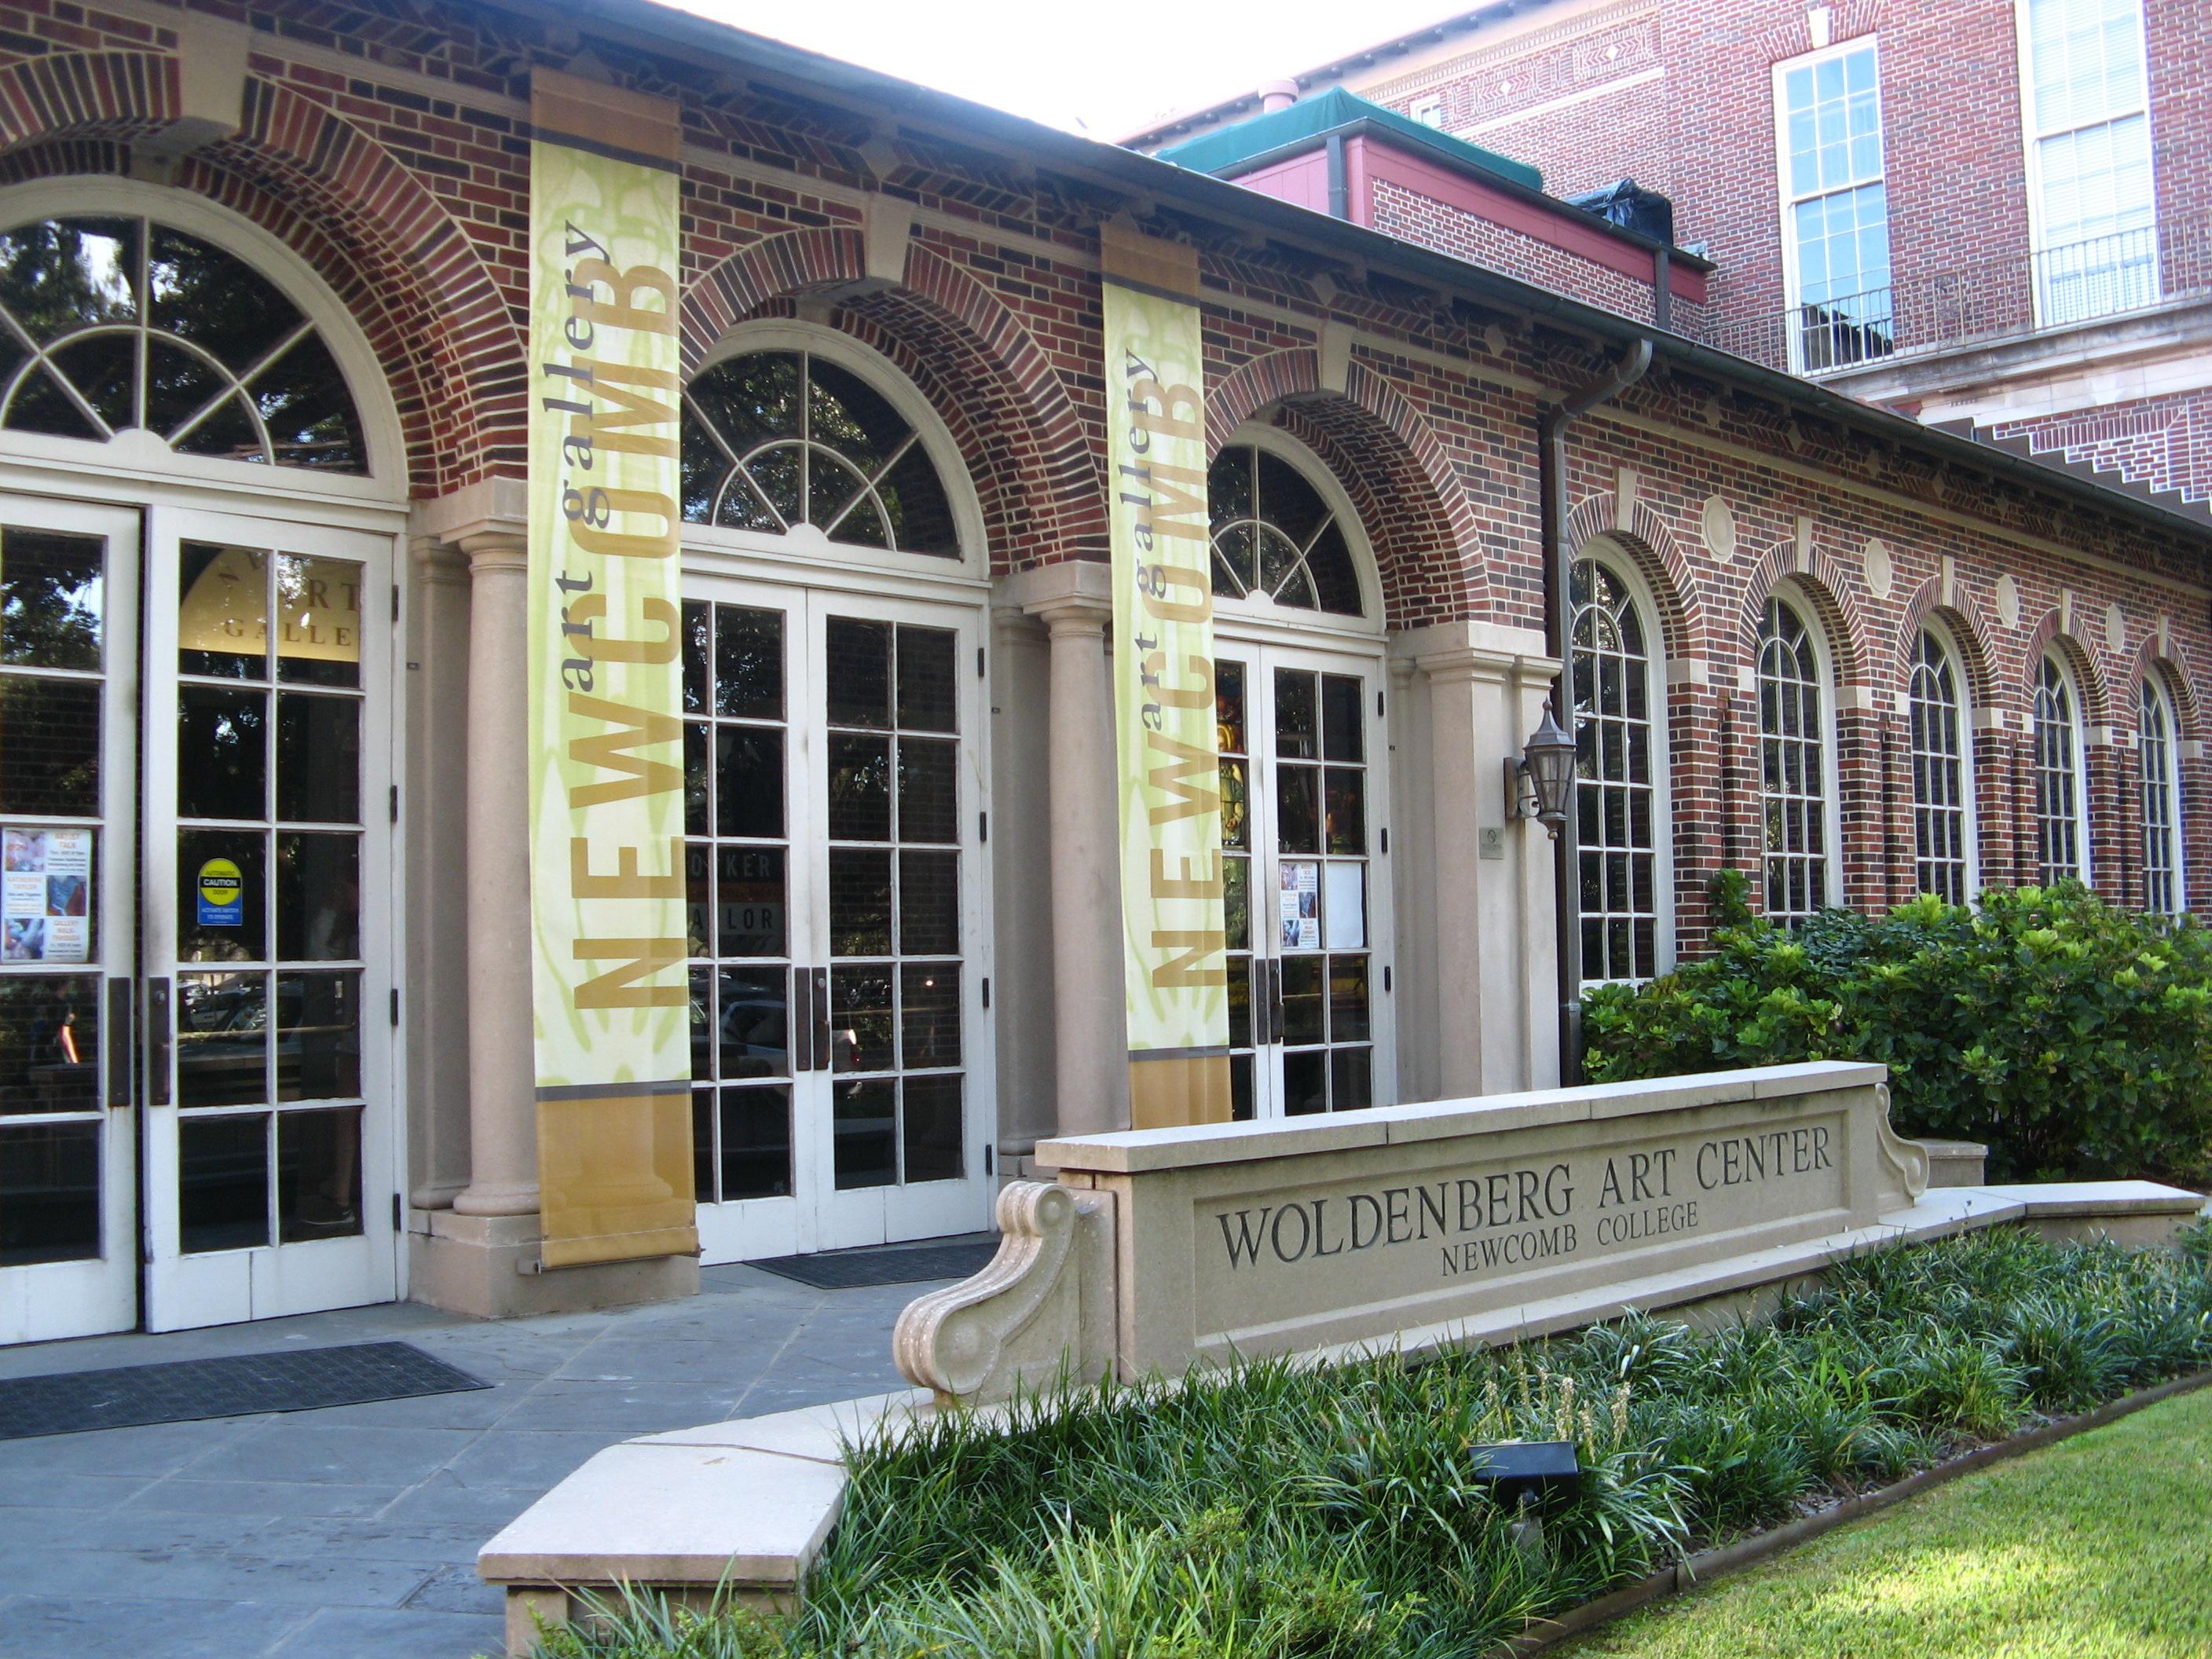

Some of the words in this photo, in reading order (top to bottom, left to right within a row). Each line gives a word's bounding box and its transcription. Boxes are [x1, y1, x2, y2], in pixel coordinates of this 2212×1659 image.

[542, 220, 610, 529] gallery
[1119, 347, 1166, 599] gallery
[280, 579, 361, 611] RT
[555, 567, 594, 692] art
[568, 257, 689, 1010] NEWCOMB
[1132, 378, 1227, 988] NEWCOMB
[1135, 631, 1162, 731] art
[203, 878, 238, 887] CAUTION
[690, 852, 771, 878] OKER
[691, 907, 773, 930] ALOR
[1216, 1164, 1574, 1271] WOLDENBERG
[1597, 1148, 1675, 1209] ART
[1696, 1126, 1833, 1190] CENTER
[1441, 1224, 1577, 1276] NEWCOMB
[1597, 1201, 1699, 1246] COLLEGE
